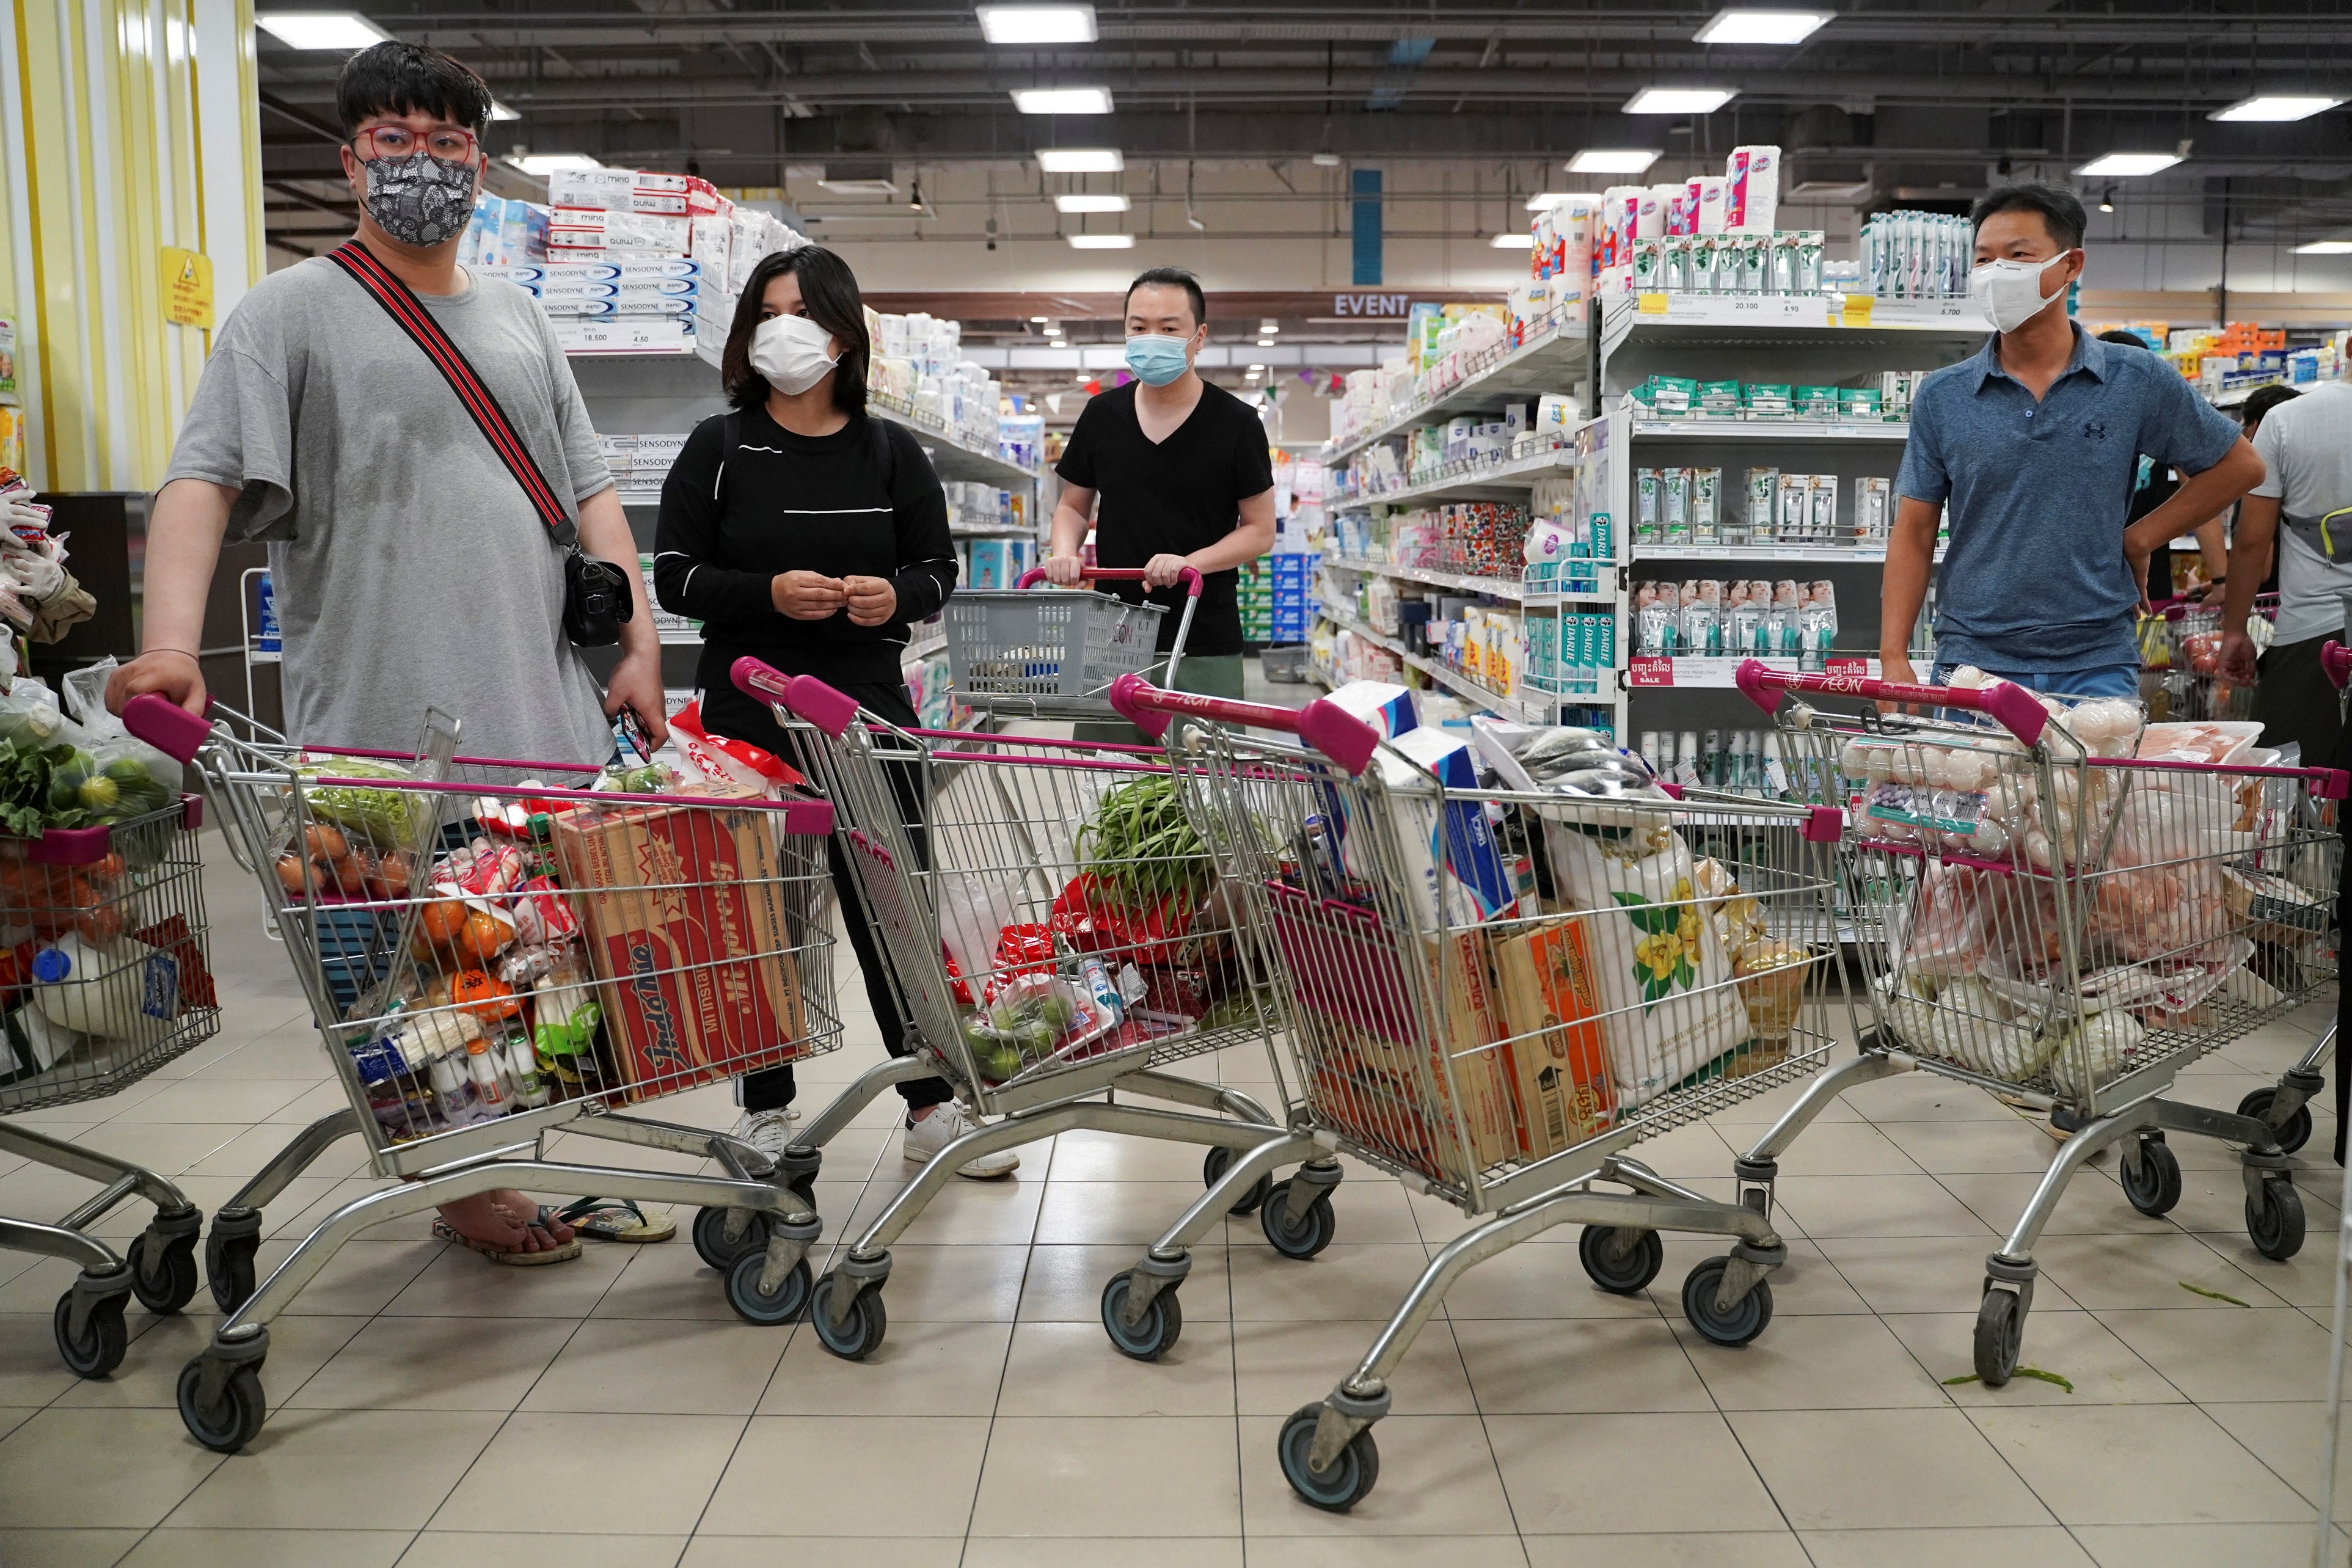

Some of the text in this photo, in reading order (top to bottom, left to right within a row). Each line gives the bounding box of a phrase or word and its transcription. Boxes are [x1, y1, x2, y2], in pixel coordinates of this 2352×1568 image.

[1335, 294, 1408, 316] EVENT
[1597, 527, 1605, 558] DARLI
[1566, 627, 1576, 662] DARLIE
[1584, 629, 1593, 663] DARLIE
[1601, 628, 1610, 663] DARLIE
[770, 913, 780, 937] SUKSES
[784, 988, 791, 997] PT
